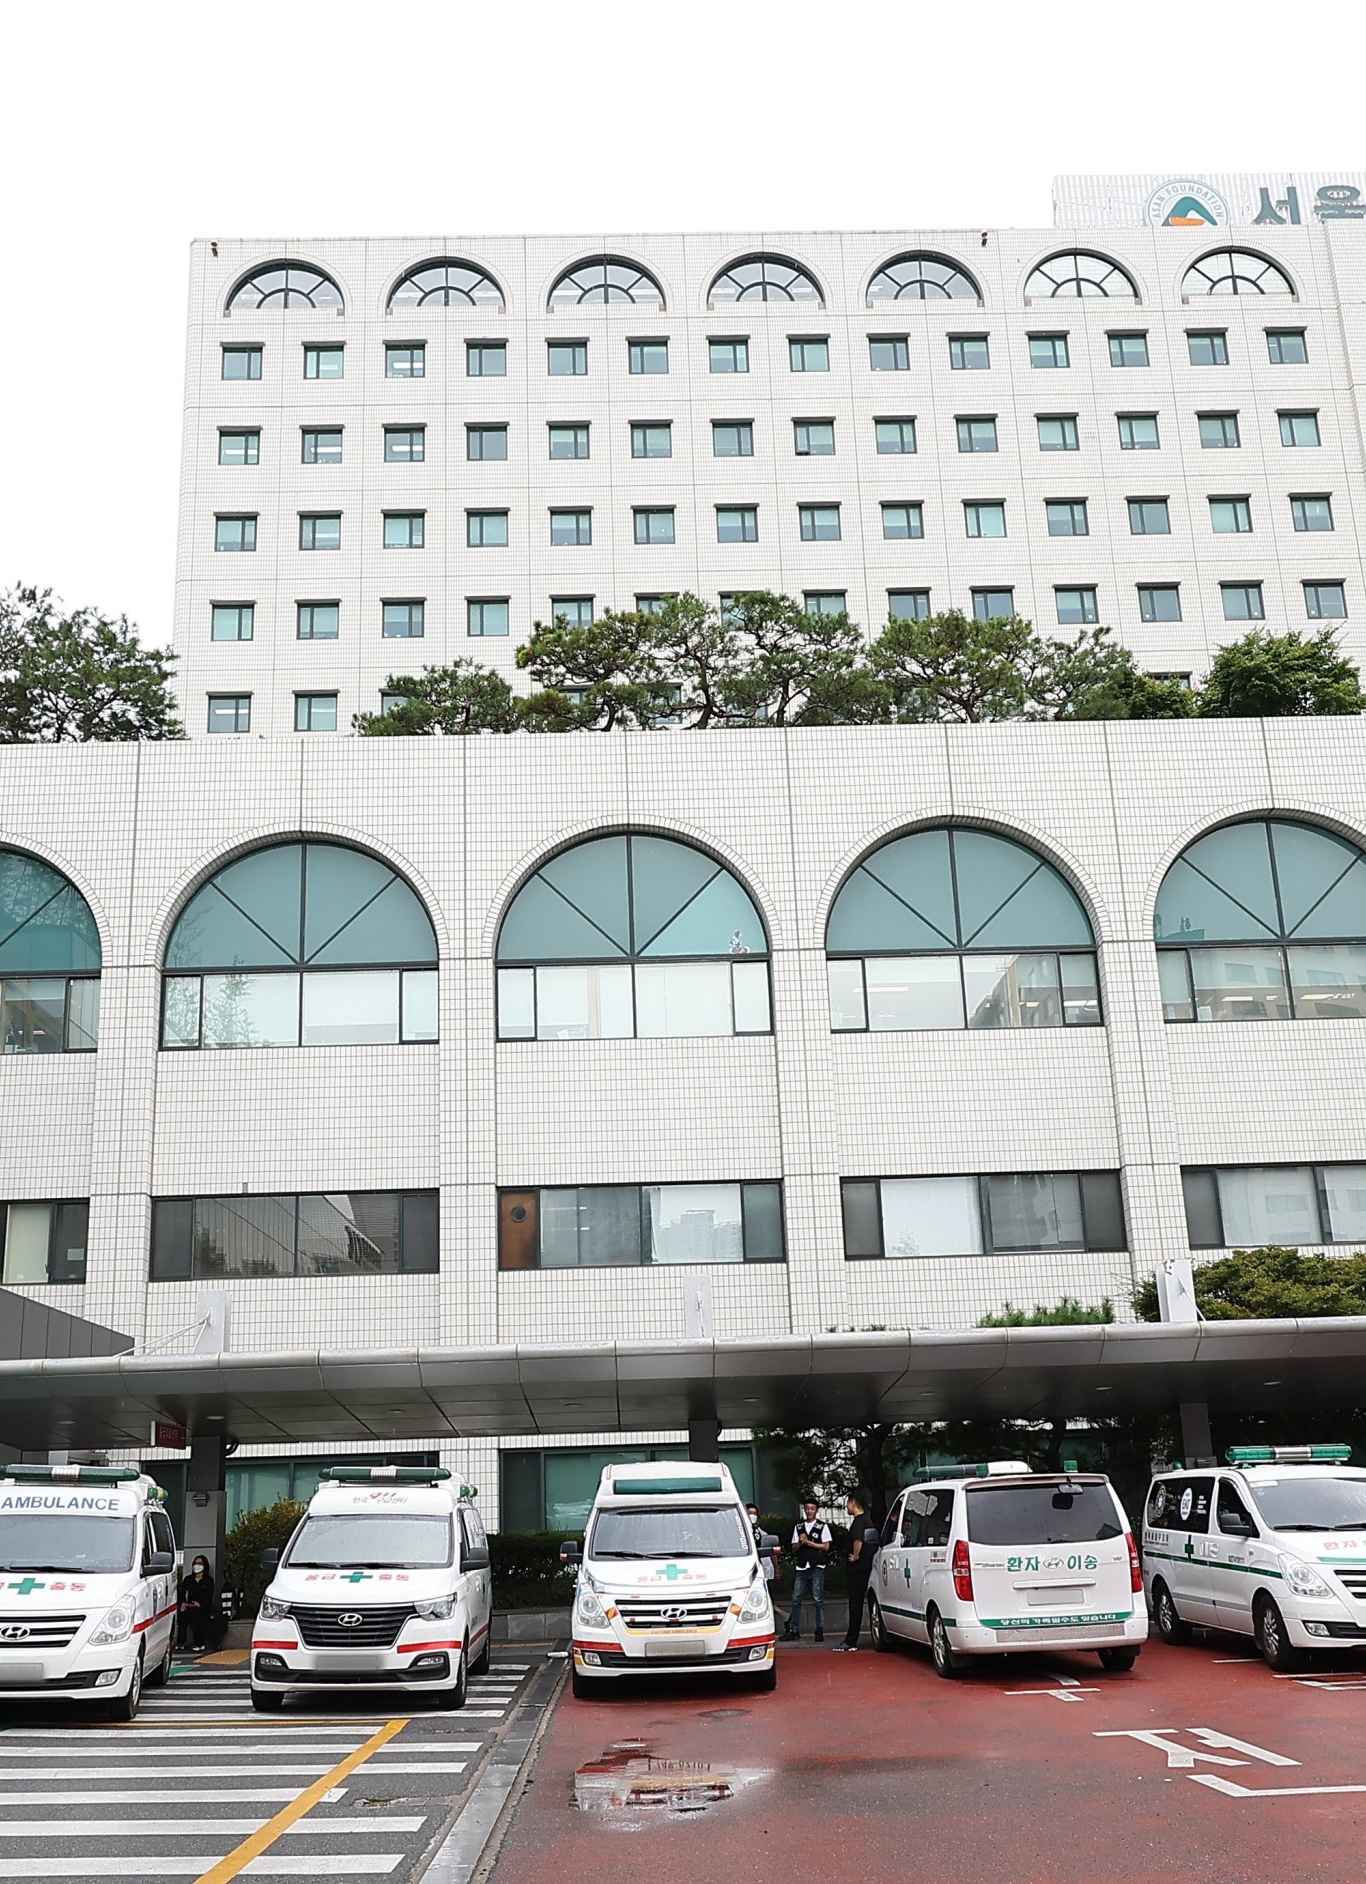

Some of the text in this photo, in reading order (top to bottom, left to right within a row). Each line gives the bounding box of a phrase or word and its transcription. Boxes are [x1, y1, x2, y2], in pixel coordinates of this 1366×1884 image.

[1154, 184, 1225, 219] ASAN FOUNDATION
[1, 1496, 120, 1511] AMBULANCE
[1006, 1556, 1040, 1572] 환자
[1067, 1554, 1098, 1570] 이송
[50, 1581, 87, 1593] 출동
